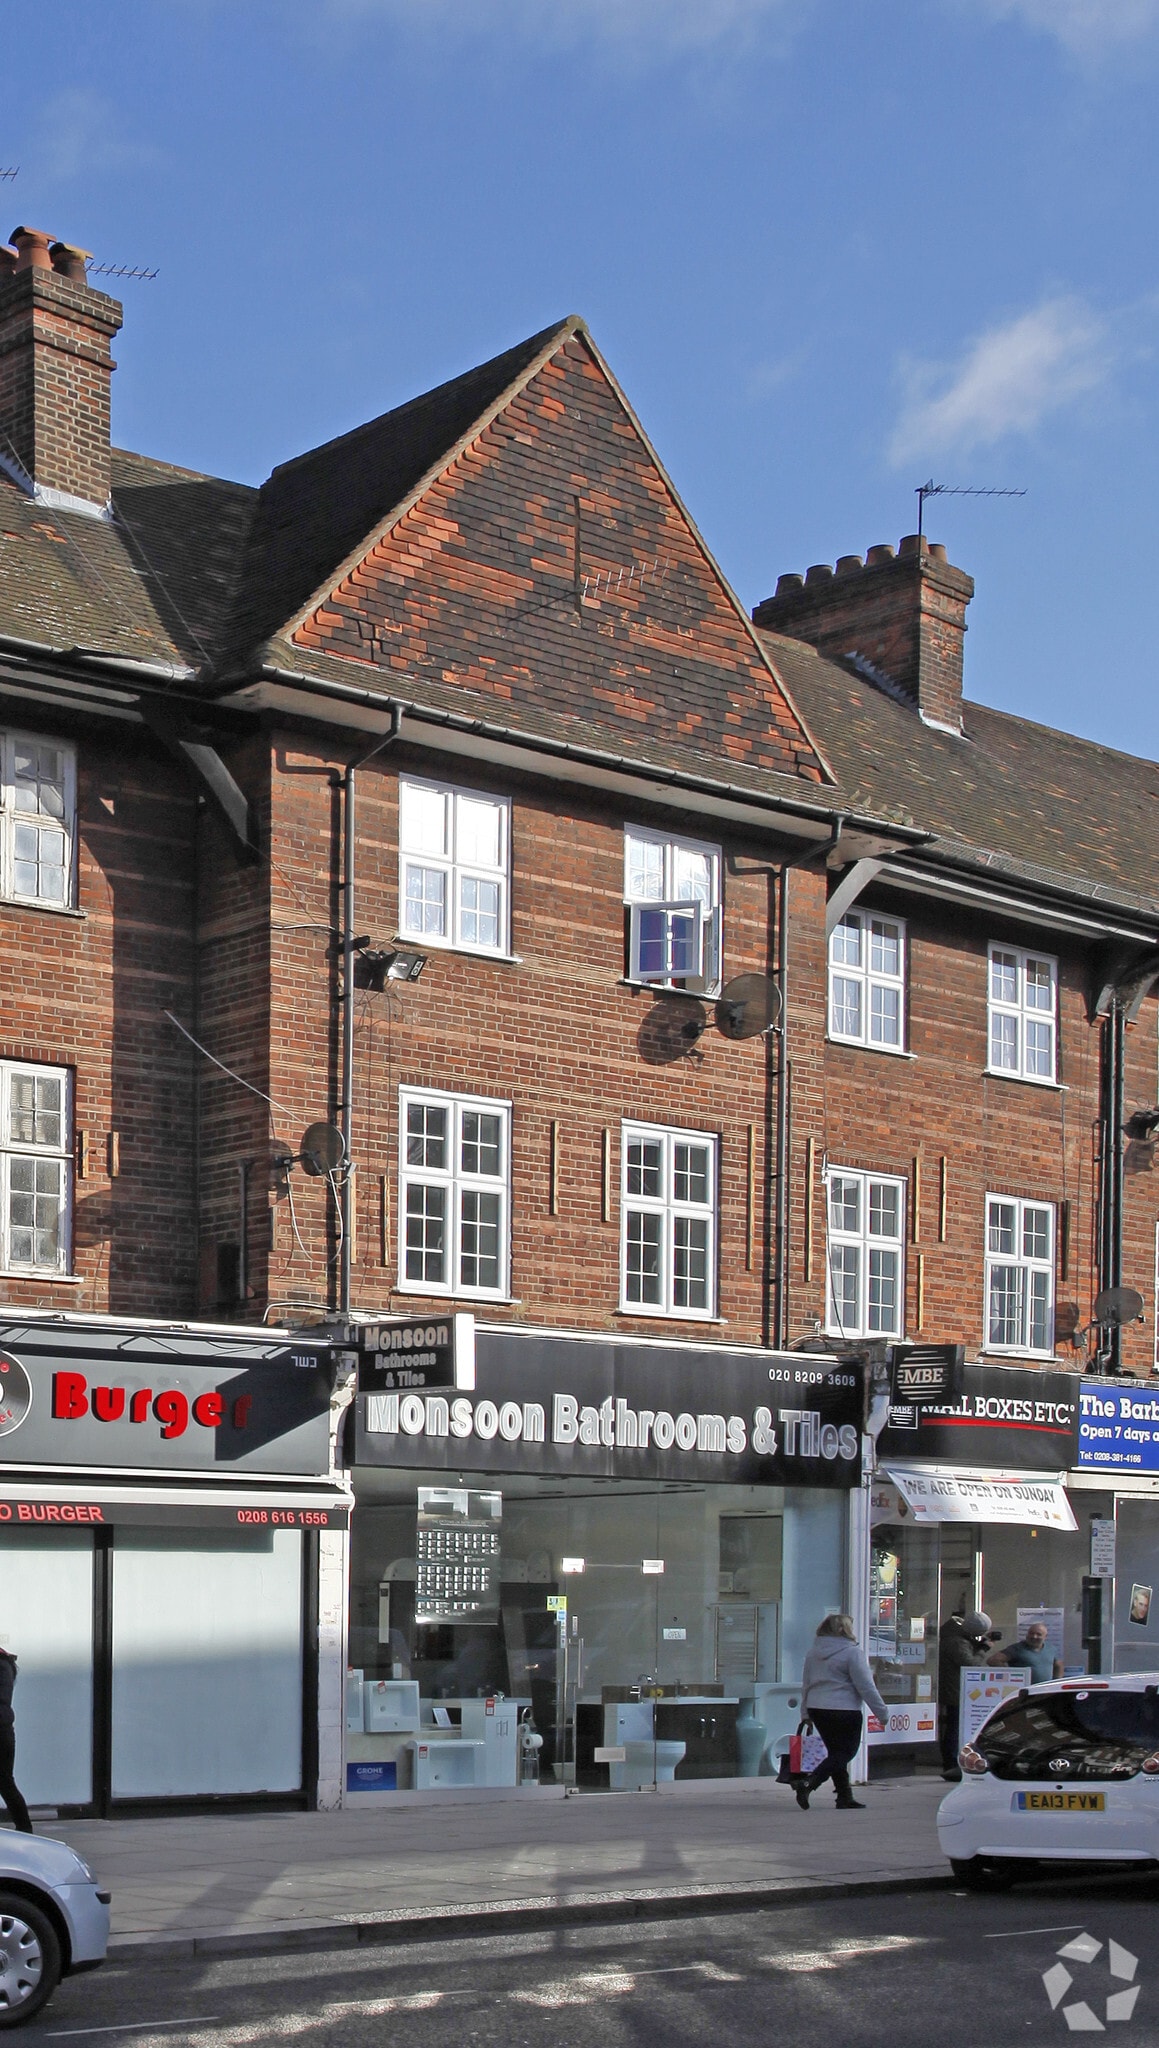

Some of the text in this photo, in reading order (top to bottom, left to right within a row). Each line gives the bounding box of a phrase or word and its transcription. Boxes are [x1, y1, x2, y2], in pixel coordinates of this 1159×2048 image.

[365, 1324, 449, 1351] Monsoon
[375, 1352, 437, 1369] Bathrooms
[385, 1371, 425, 1387] & Tiles
[768, 1369, 856, 1387] 020 8209 3608
[903, 1367, 944, 1385] MBE
[52, 1371, 252, 1439] Burger
[974, 1396, 1032, 1420] BOXES
[1079, 1394, 1116, 1418] The
[368, 1393, 858, 1460] Monsoon Bathrooms & Tiles
[1080, 1423, 1112, 1440] Open
[1114, 1425, 1122, 1439] 7
[1123, 1426, 1151, 1444] days
[1079, 1451, 1092, 1460] Tel:
[904, 1478, 1056, 1505] WE ARE OPEN ON SUNDAY
[17, 1503, 104, 1522] BURGER
[237, 1510, 329, 1526] 0208 616 1556
[1030, 1794, 1098, 1809] EA13 FVW
